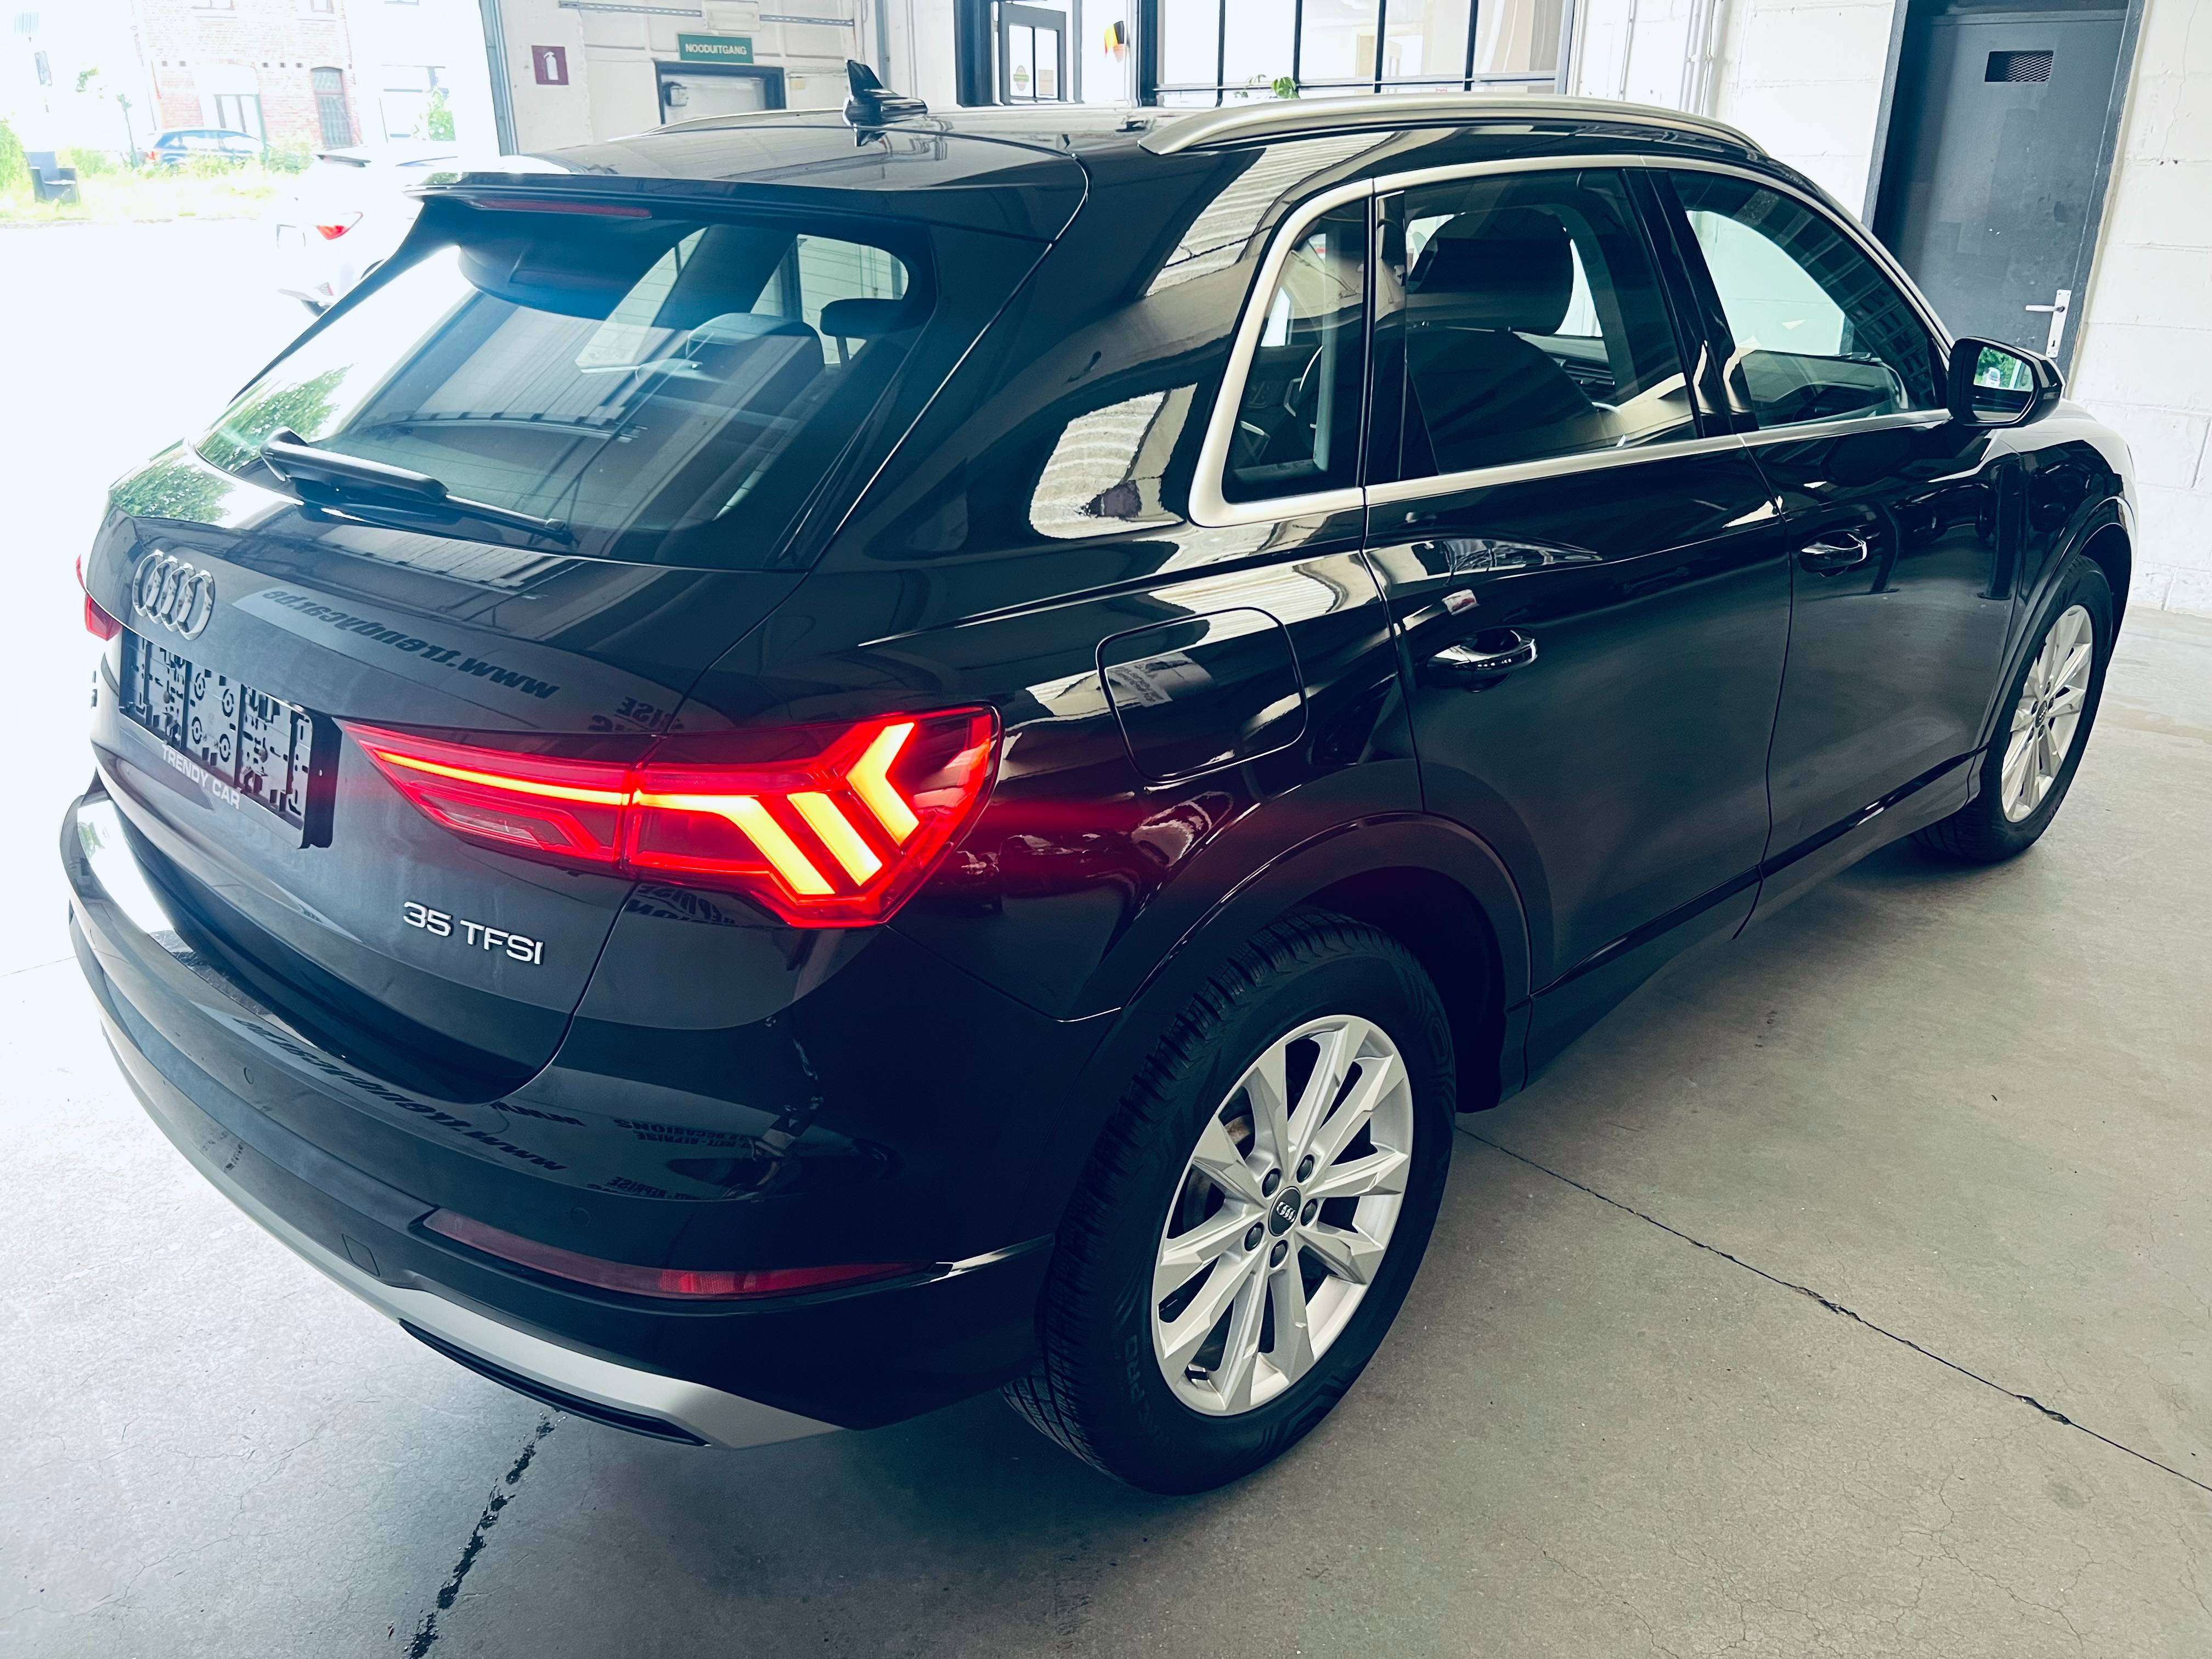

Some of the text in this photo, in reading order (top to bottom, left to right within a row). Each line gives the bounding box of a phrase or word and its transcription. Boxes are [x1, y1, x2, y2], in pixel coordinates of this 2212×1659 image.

[685, 43, 747, 55] NOODUITGANG
[162, 743, 240, 809] TRENDY CAR
[403, 901, 544, 965] 35 TFSI
